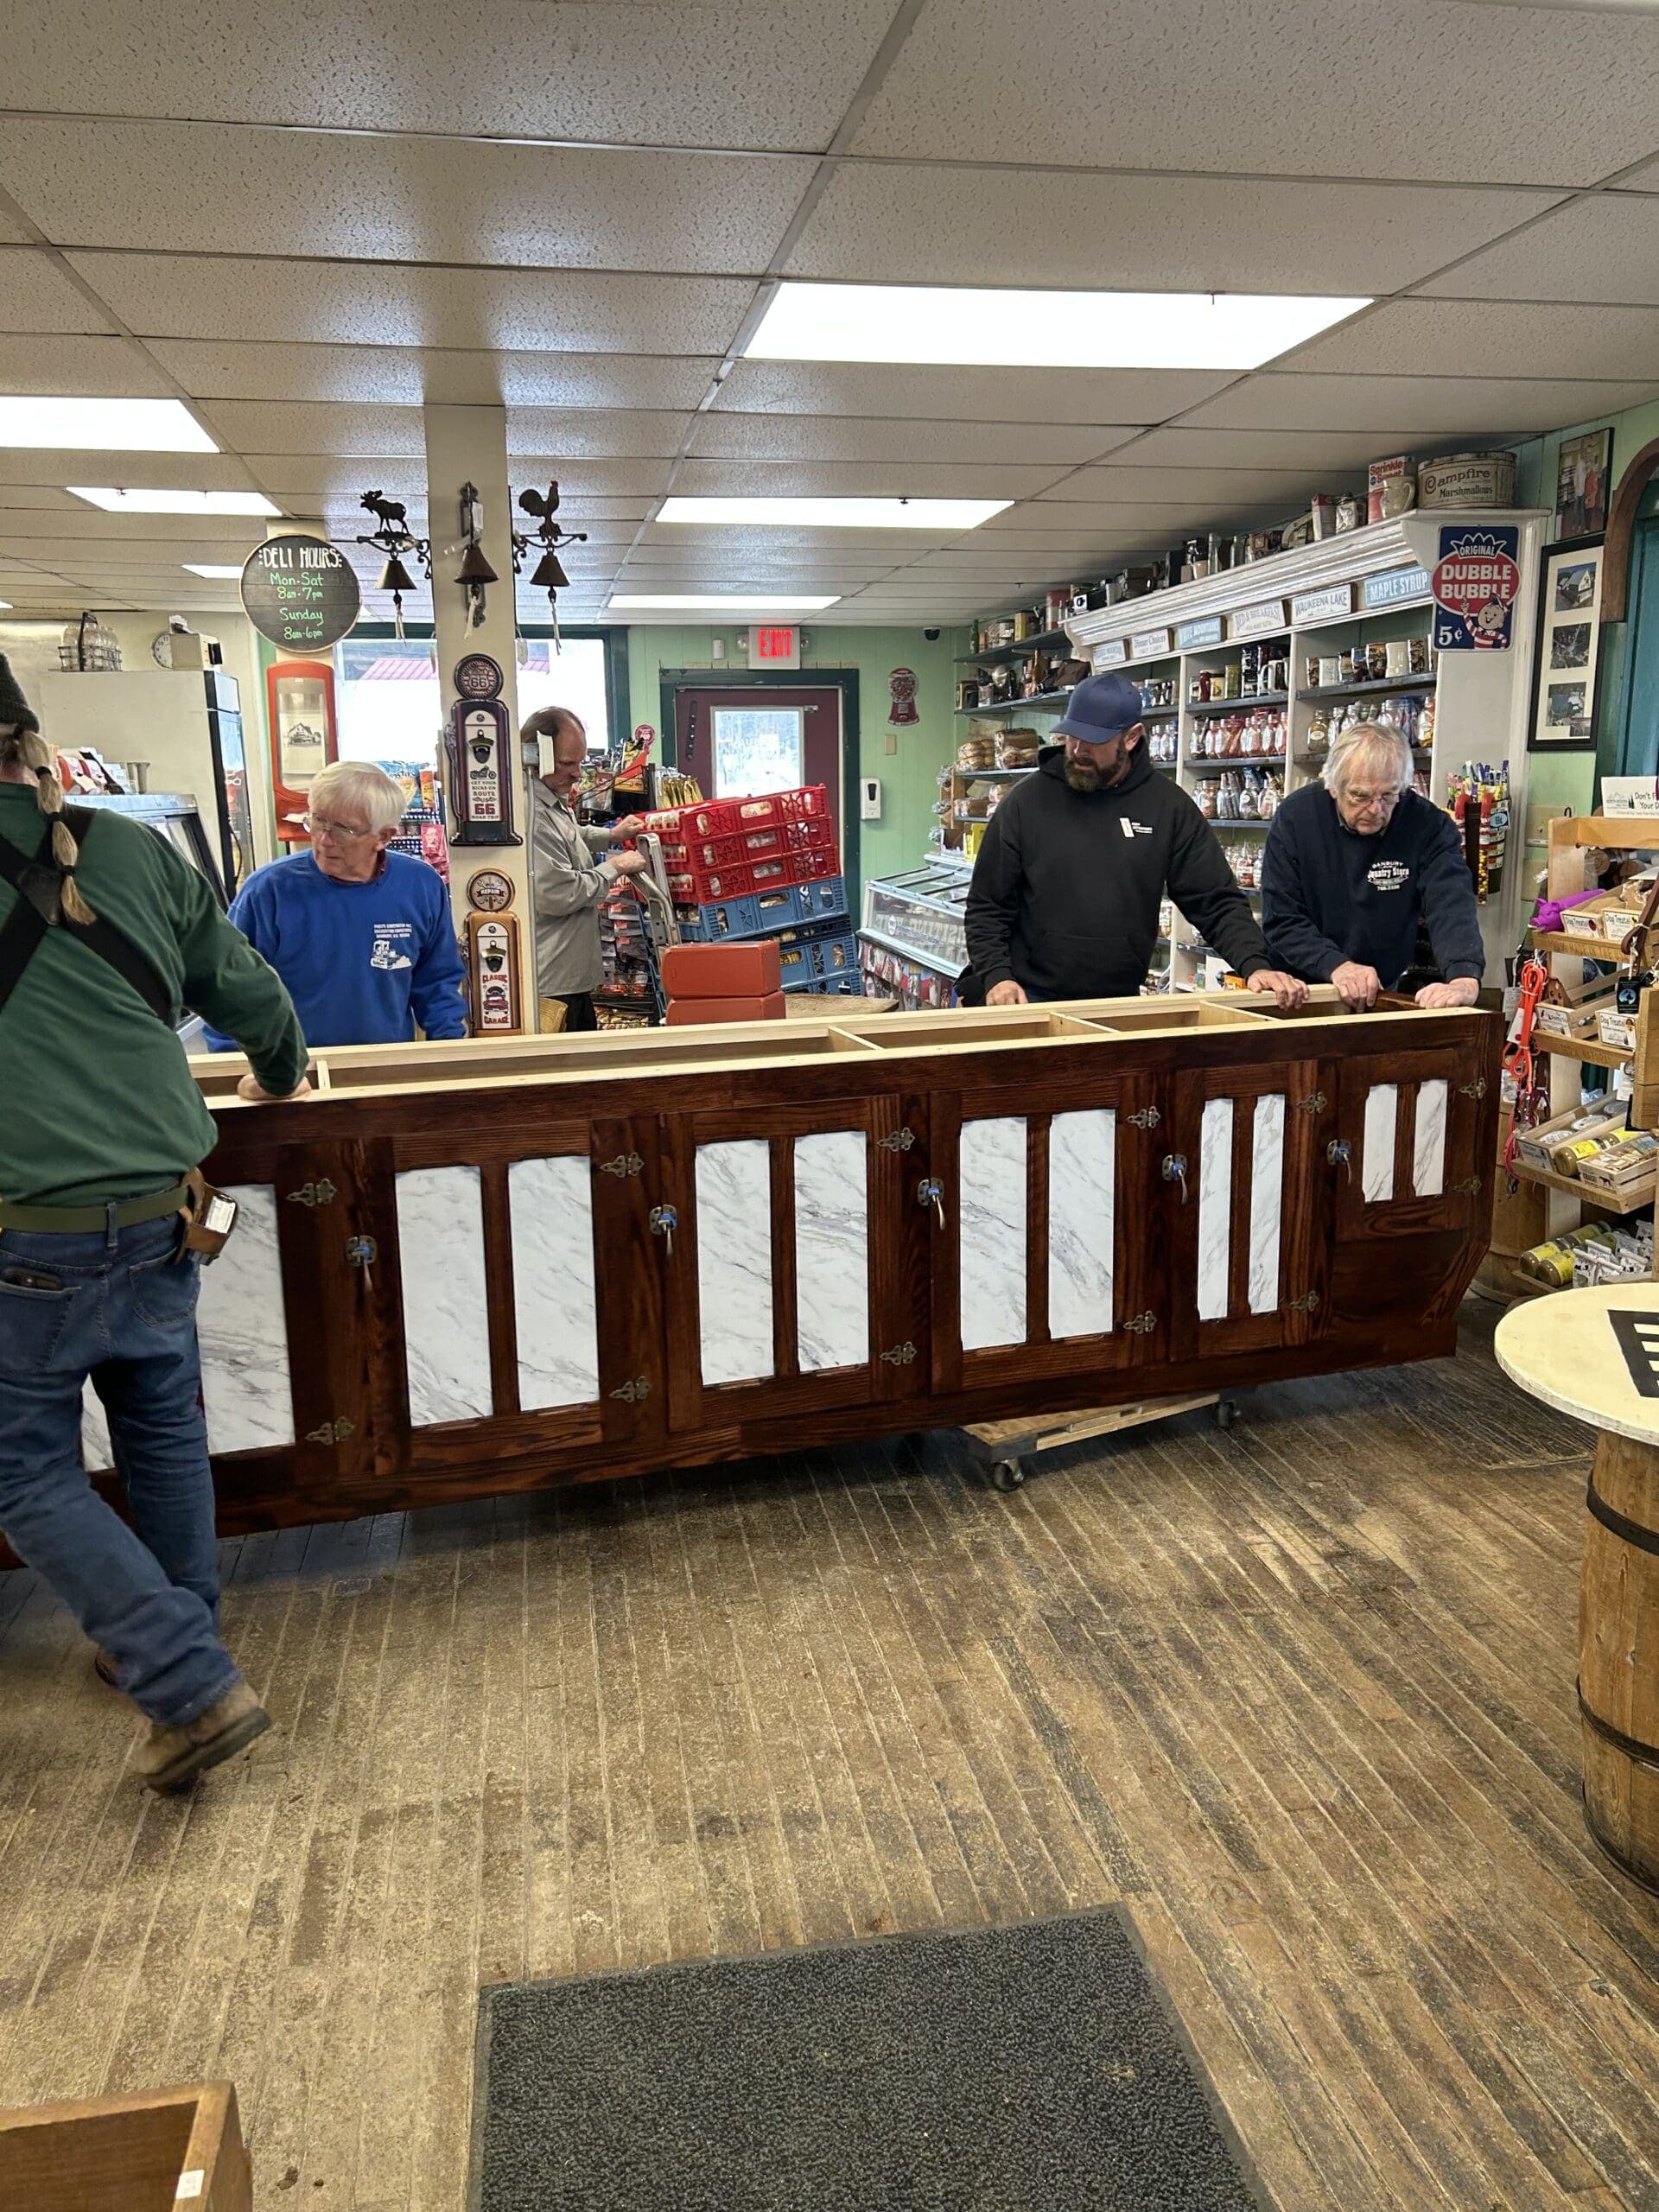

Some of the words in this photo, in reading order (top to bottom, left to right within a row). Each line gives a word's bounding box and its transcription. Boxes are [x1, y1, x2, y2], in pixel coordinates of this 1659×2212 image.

[1425, 468, 1492, 494] Campfire
[262, 547, 292, 569] DELI
[1459, 544, 1495, 556] ORIGINAL
[1440, 564, 1512, 581] DUBBLE
[1370, 579, 1397, 601] MAPLE
[1400, 571, 1428, 594] SYRUP
[1440, 583, 1510, 599] BUBBLE
[1330, 591, 1348, 607] LAKE
[279, 607, 324, 626] Sunday
[759, 629, 793, 658] EXIT
[471, 677, 487, 689] 66
[474, 803, 496, 815] 66
[1639, 801, 1654, 810] Your
[482, 974, 508, 983] CLASSIC
[484, 1015, 510, 1024] GARAGE
